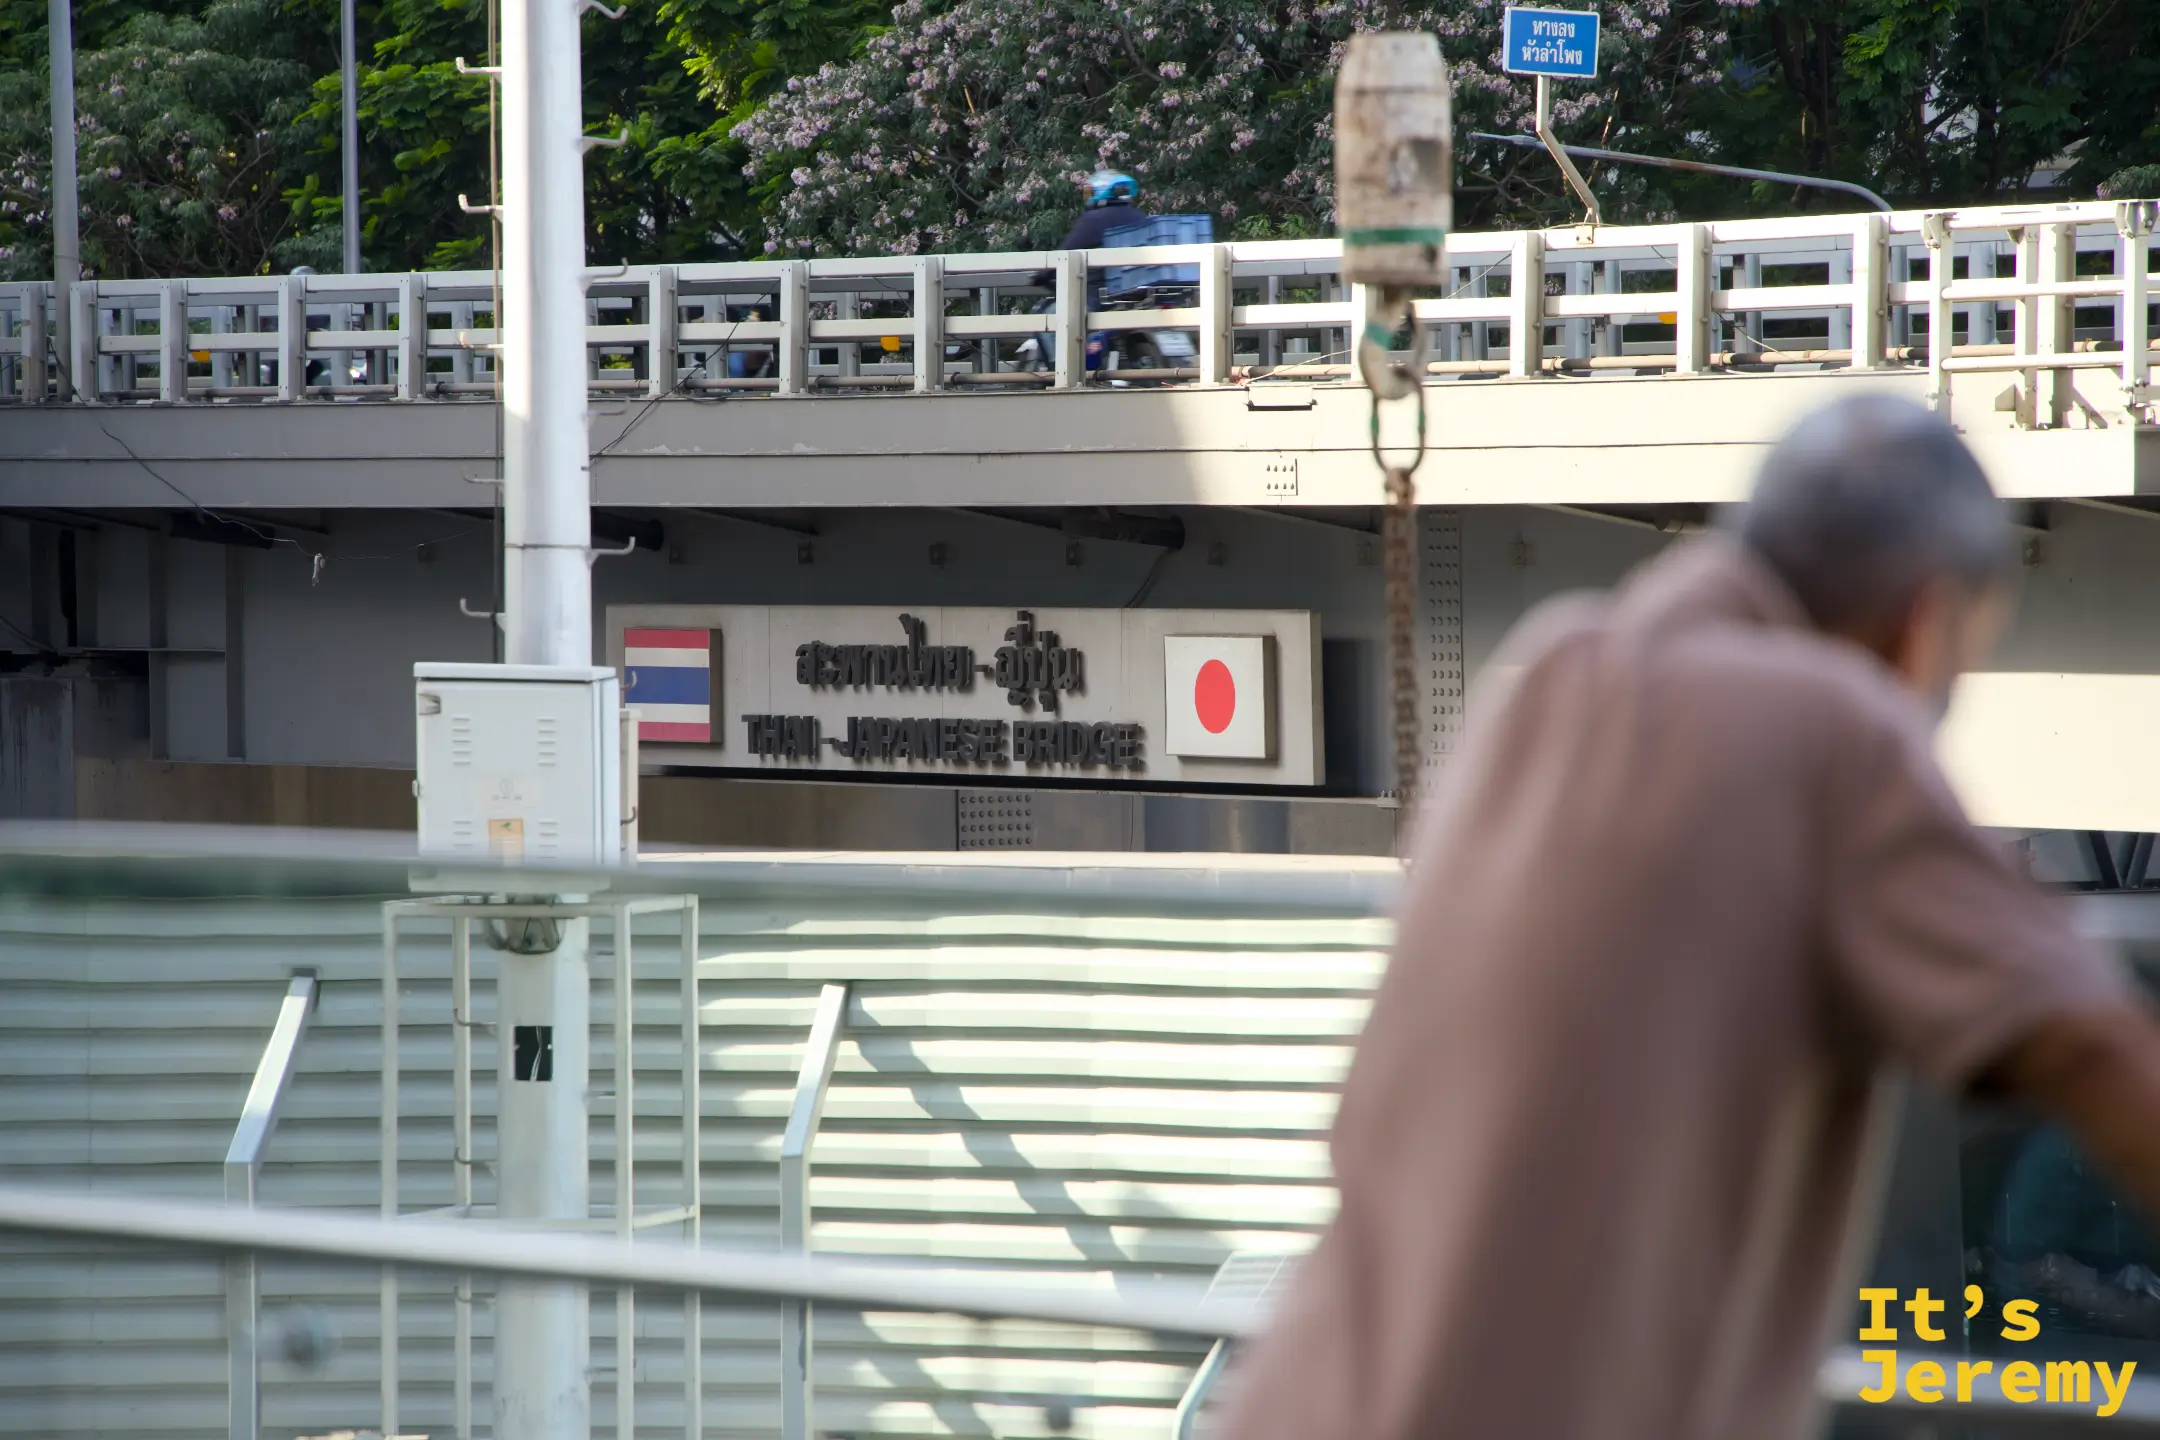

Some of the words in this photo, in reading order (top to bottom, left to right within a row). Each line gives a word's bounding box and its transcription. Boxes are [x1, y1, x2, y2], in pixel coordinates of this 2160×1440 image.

[1532, 20, 1576, 38] ทางลง
[1521, 39, 1583, 65] หัวลำโพง
[795, 610, 1082, 713] สะพานไทย-ญี่ปุ่น
[741, 714, 1006, 763] THAI-JAPANESE
[1012, 720, 1143, 768] BRIDGE
